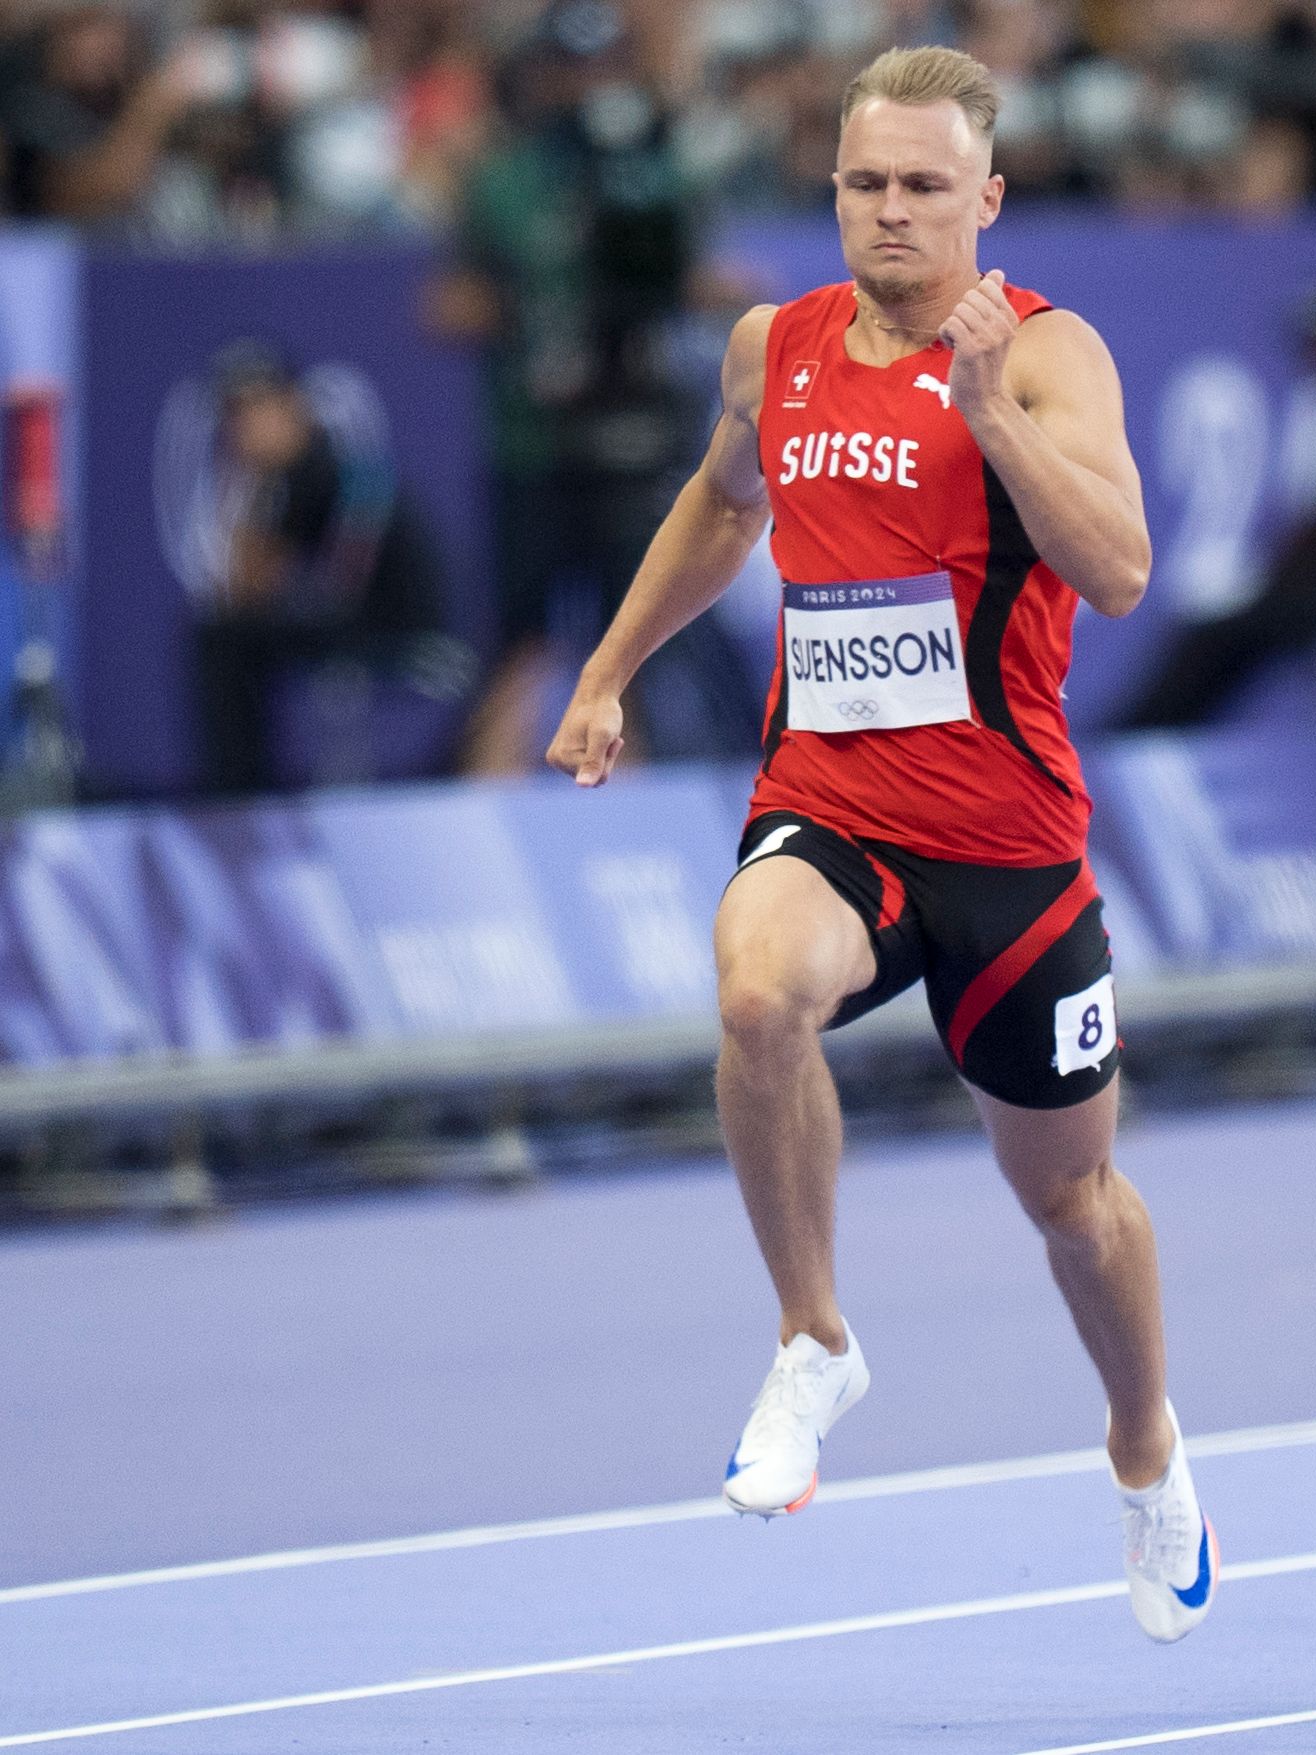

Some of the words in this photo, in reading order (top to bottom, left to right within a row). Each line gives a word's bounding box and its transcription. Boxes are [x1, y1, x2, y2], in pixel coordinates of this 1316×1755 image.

[802, 589, 847, 604] PARIS
[850, 586, 897, 602] 2024
[1078, 1003, 1103, 1051] 8
